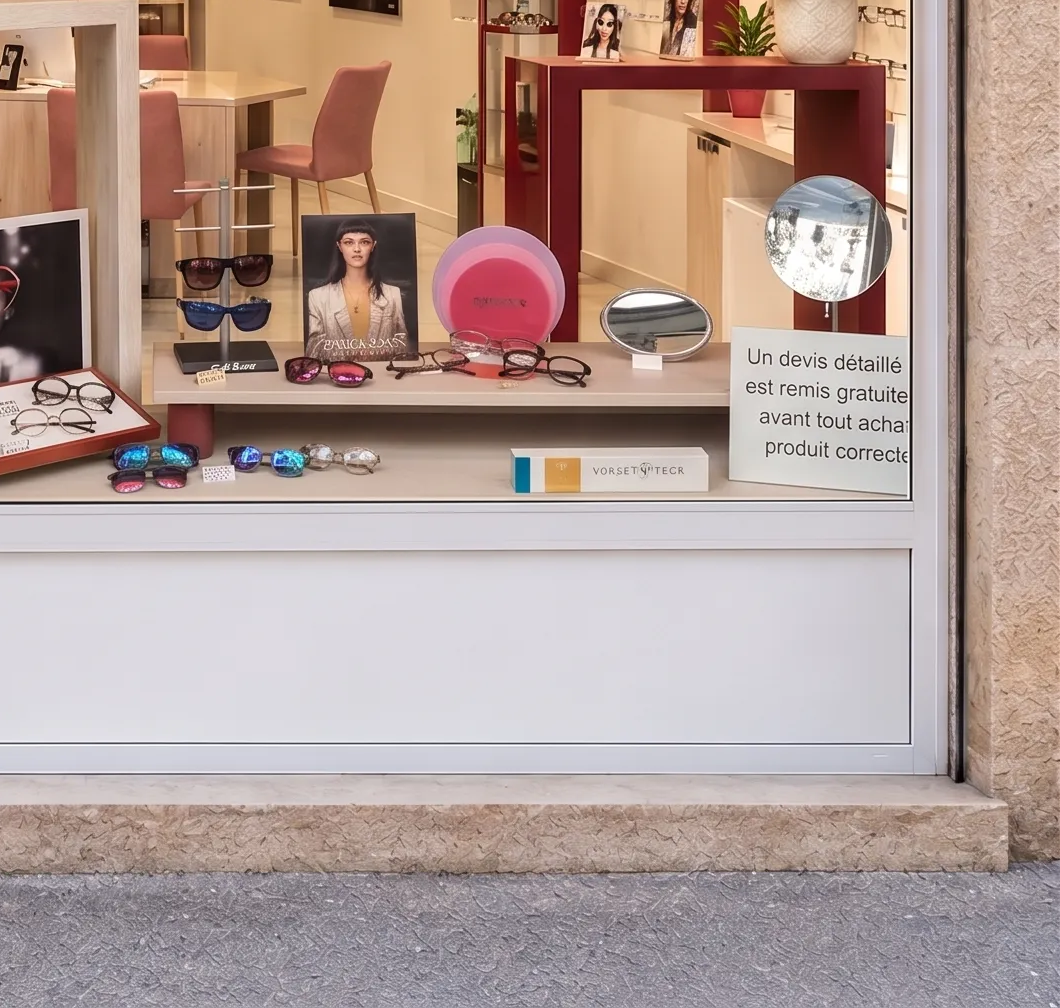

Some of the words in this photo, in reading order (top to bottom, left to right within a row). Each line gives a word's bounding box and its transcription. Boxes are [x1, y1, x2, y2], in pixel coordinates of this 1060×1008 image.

[747, 347, 773, 366] Un
[779, 350, 828, 370] devis
[834, 353, 902, 374] détaillé
[745, 379, 774, 396] est
[779, 382, 830, 399] remis
[837, 385, 908, 404] gratuite
[759, 411, 811, 428] avant
[816, 411, 853, 430] tout
[765, 439, 830, 459] produit
